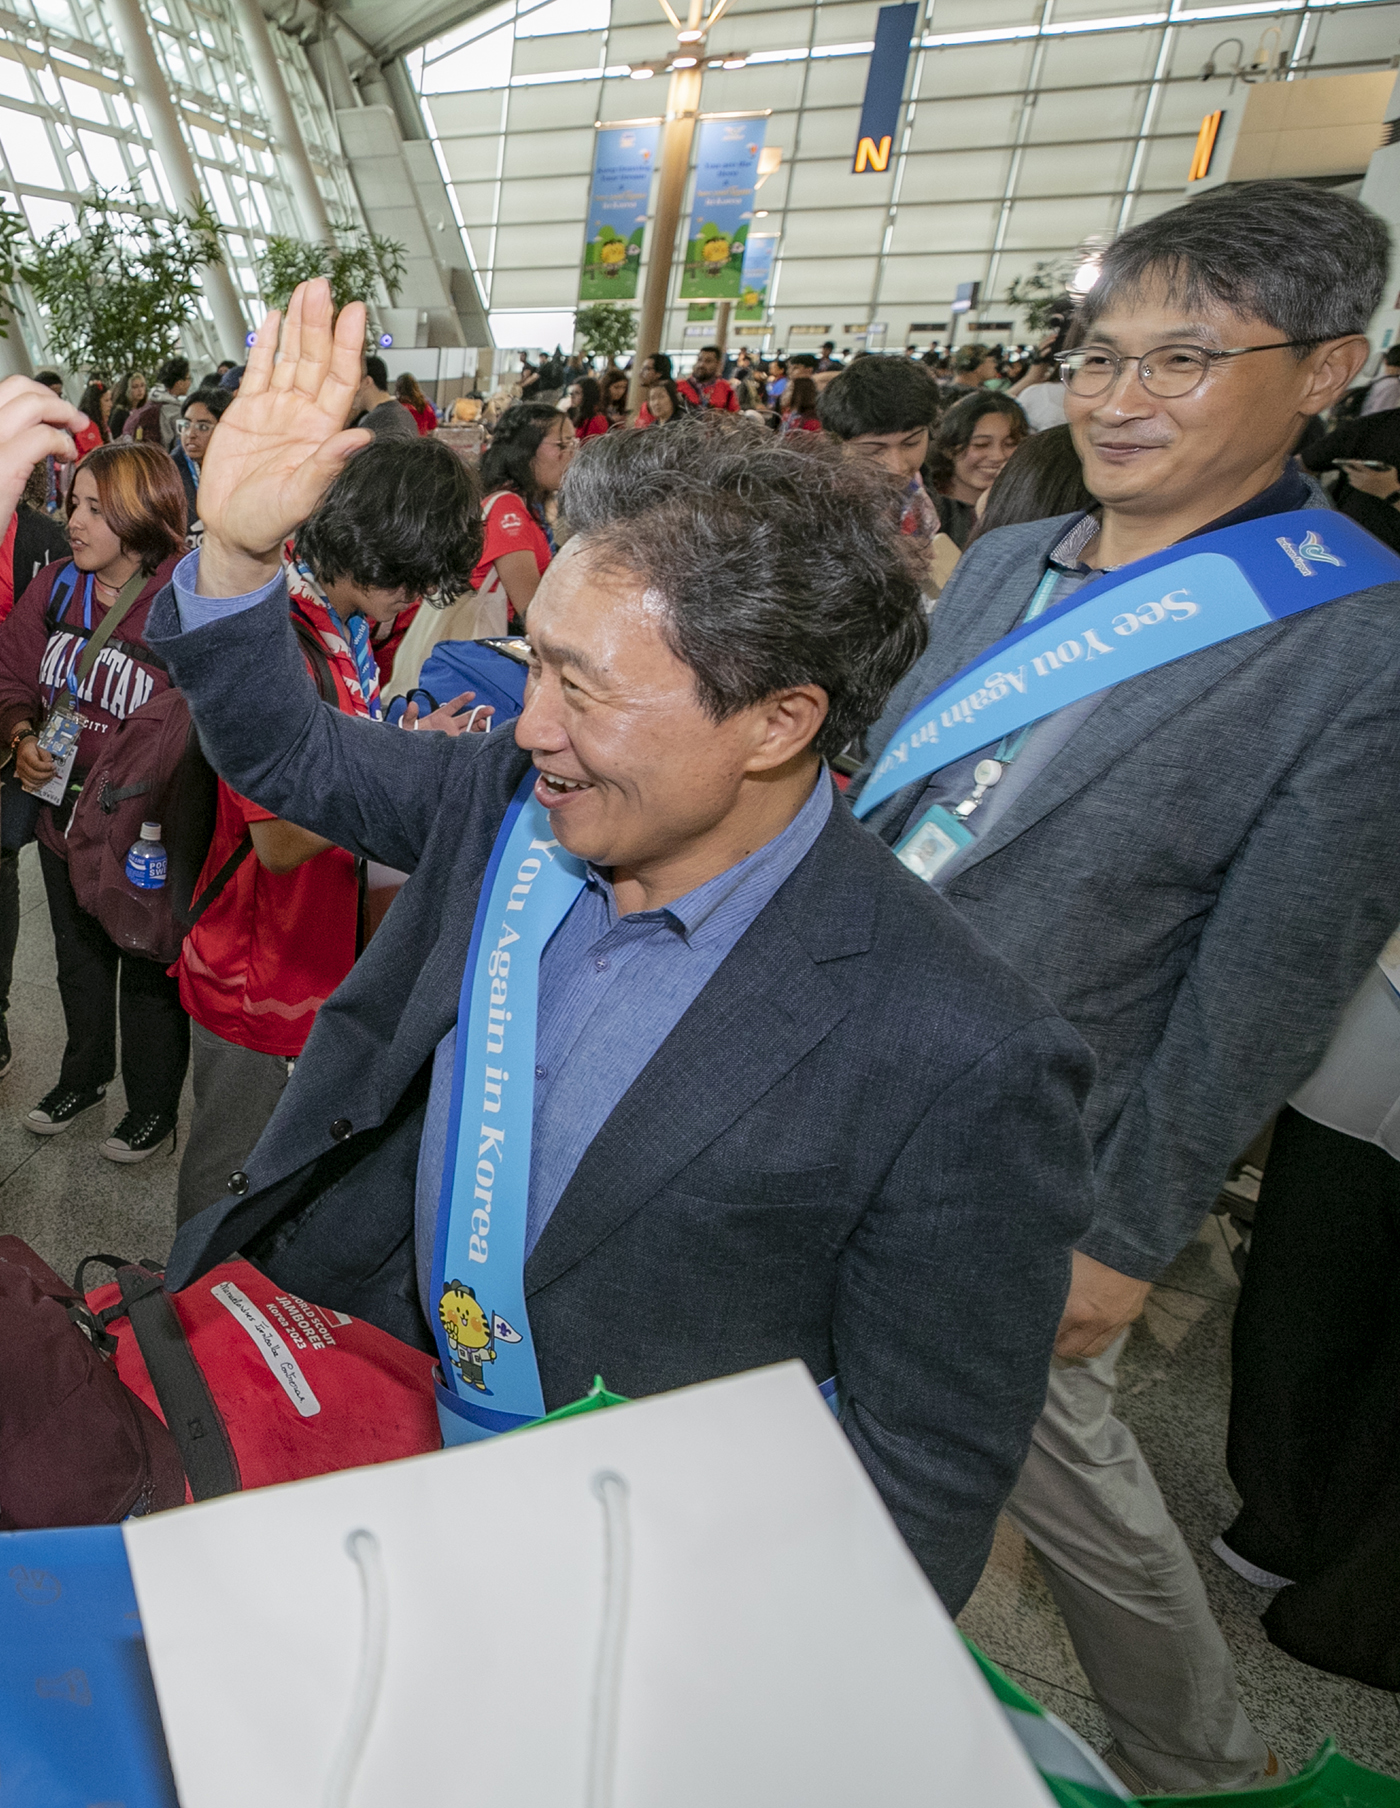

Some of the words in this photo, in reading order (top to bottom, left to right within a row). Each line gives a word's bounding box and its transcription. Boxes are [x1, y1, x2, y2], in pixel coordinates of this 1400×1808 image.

[854, 135, 892, 173] N
[1111, 588, 1199, 636] See
[1030, 627, 1114, 678] You
[940, 663, 1028, 728] Again
[910, 720, 941, 749] in
[505, 837, 561, 912] You
[486, 919, 522, 1055] Again
[483, 1064, 511, 1114] in
[468, 1122, 506, 1266] Korea
[266, 1303, 289, 1327] Korea
[285, 1326, 308, 1350] 2023
[275, 1296, 326, 1350] JAMBOREE
[311, 1314, 337, 1346] SCOUT
